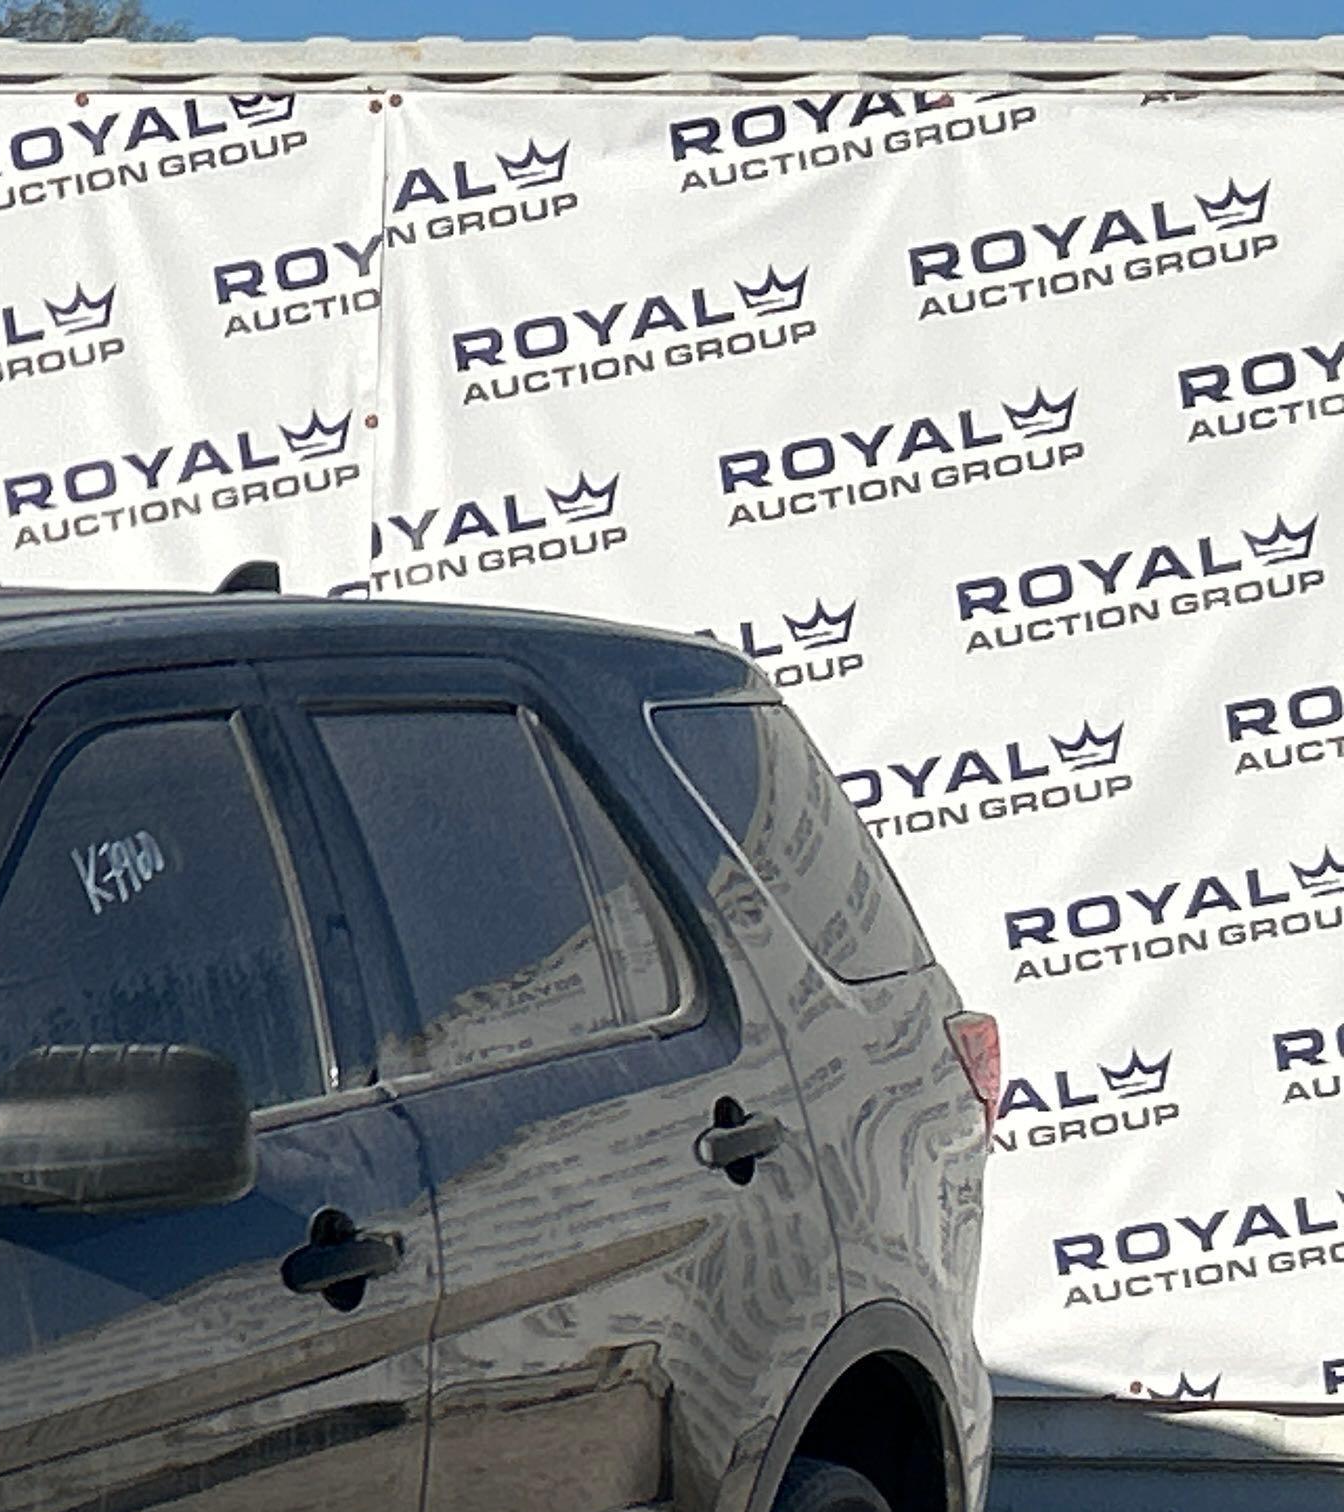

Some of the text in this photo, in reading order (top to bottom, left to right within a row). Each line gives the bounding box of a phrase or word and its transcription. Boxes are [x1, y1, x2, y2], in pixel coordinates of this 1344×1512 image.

[157, 130, 308, 179] GROUP
[679, 106, 1037, 194] AUCTION GROUP
[426, 192, 578, 240] GROUP
[907, 200, 1197, 288] ROYAL
[213, 233, 383, 305] ROY
[918, 233, 1279, 321] AUCTION GROUP
[224, 288, 382, 339] AUCTIO
[452, 287, 736, 373] ROYAL
[462, 320, 817, 406] AUCTION GROUP
[1178, 340, 1344, 410] ROY
[718, 408, 1004, 496] ROYAL
[1187, 393, 1344, 444] AUCTIO
[2, 431, 281, 518] ROYAL
[14, 463, 361, 550] AUCTION GROUP
[727, 441, 1085, 528] AUCTION GROUP
[370, 554, 468, 592] TION
[477, 526, 628, 573] GROUP
[372, 494, 547, 560] YAL
[955, 535, 1243, 622] ROYAL
[965, 569, 1325, 655] AUCTION GROUP
[774, 653, 864, 688] OUP
[836, 741, 1050, 810] OYAL
[1234, 735, 1344, 776] AUCT
[865, 774, 1133, 840] TION GROUP
[1004, 867, 1291, 951] ROYAL
[1013, 905, 1344, 984] AUCTION GROU
[1027, 1102, 1180, 1147] GROUP
[1052, 1196, 1339, 1277] ROYAL
[1063, 1255, 1258, 1309] AUCTION
